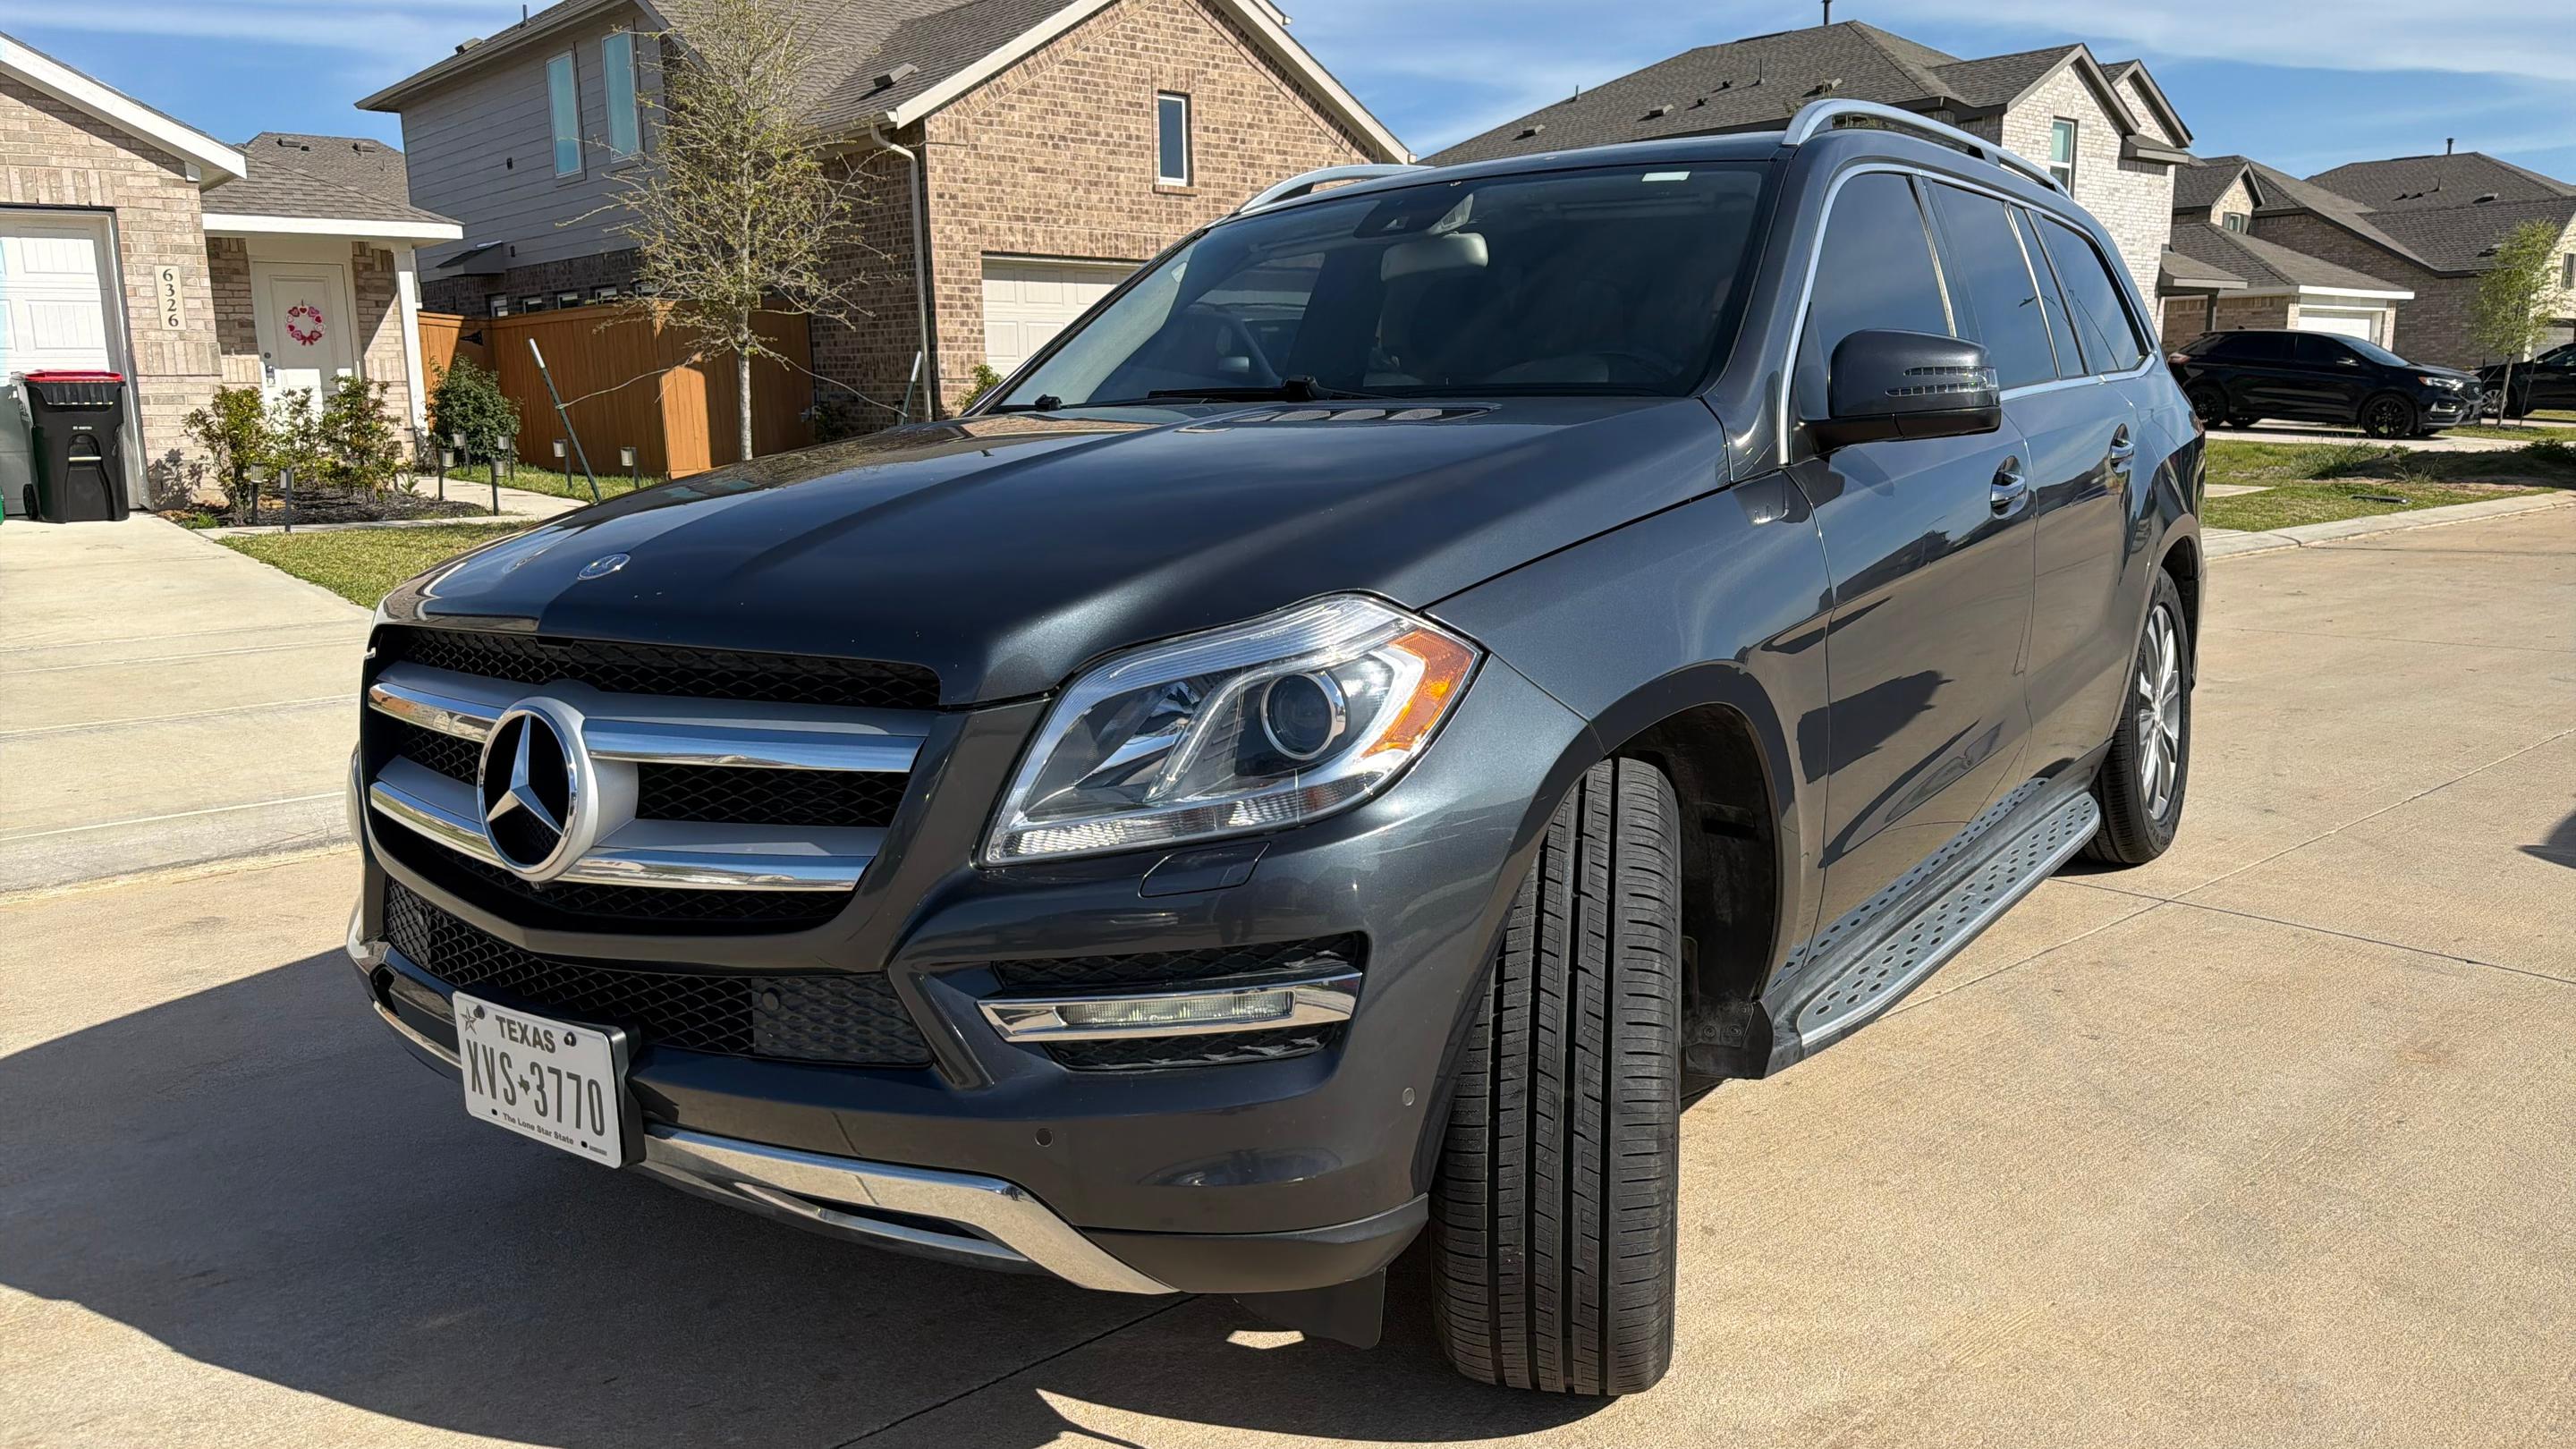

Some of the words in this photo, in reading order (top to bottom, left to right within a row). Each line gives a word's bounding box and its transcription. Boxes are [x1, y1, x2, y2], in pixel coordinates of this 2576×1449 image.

[163, 269, 179, 326] 6326
[495, 1014, 556, 1054] TEXAS
[503, 1112, 516, 1124] The
[517, 1117, 535, 1131] Lone
[537, 1124, 553, 1138] Star
[554, 1131, 574, 1145] State
